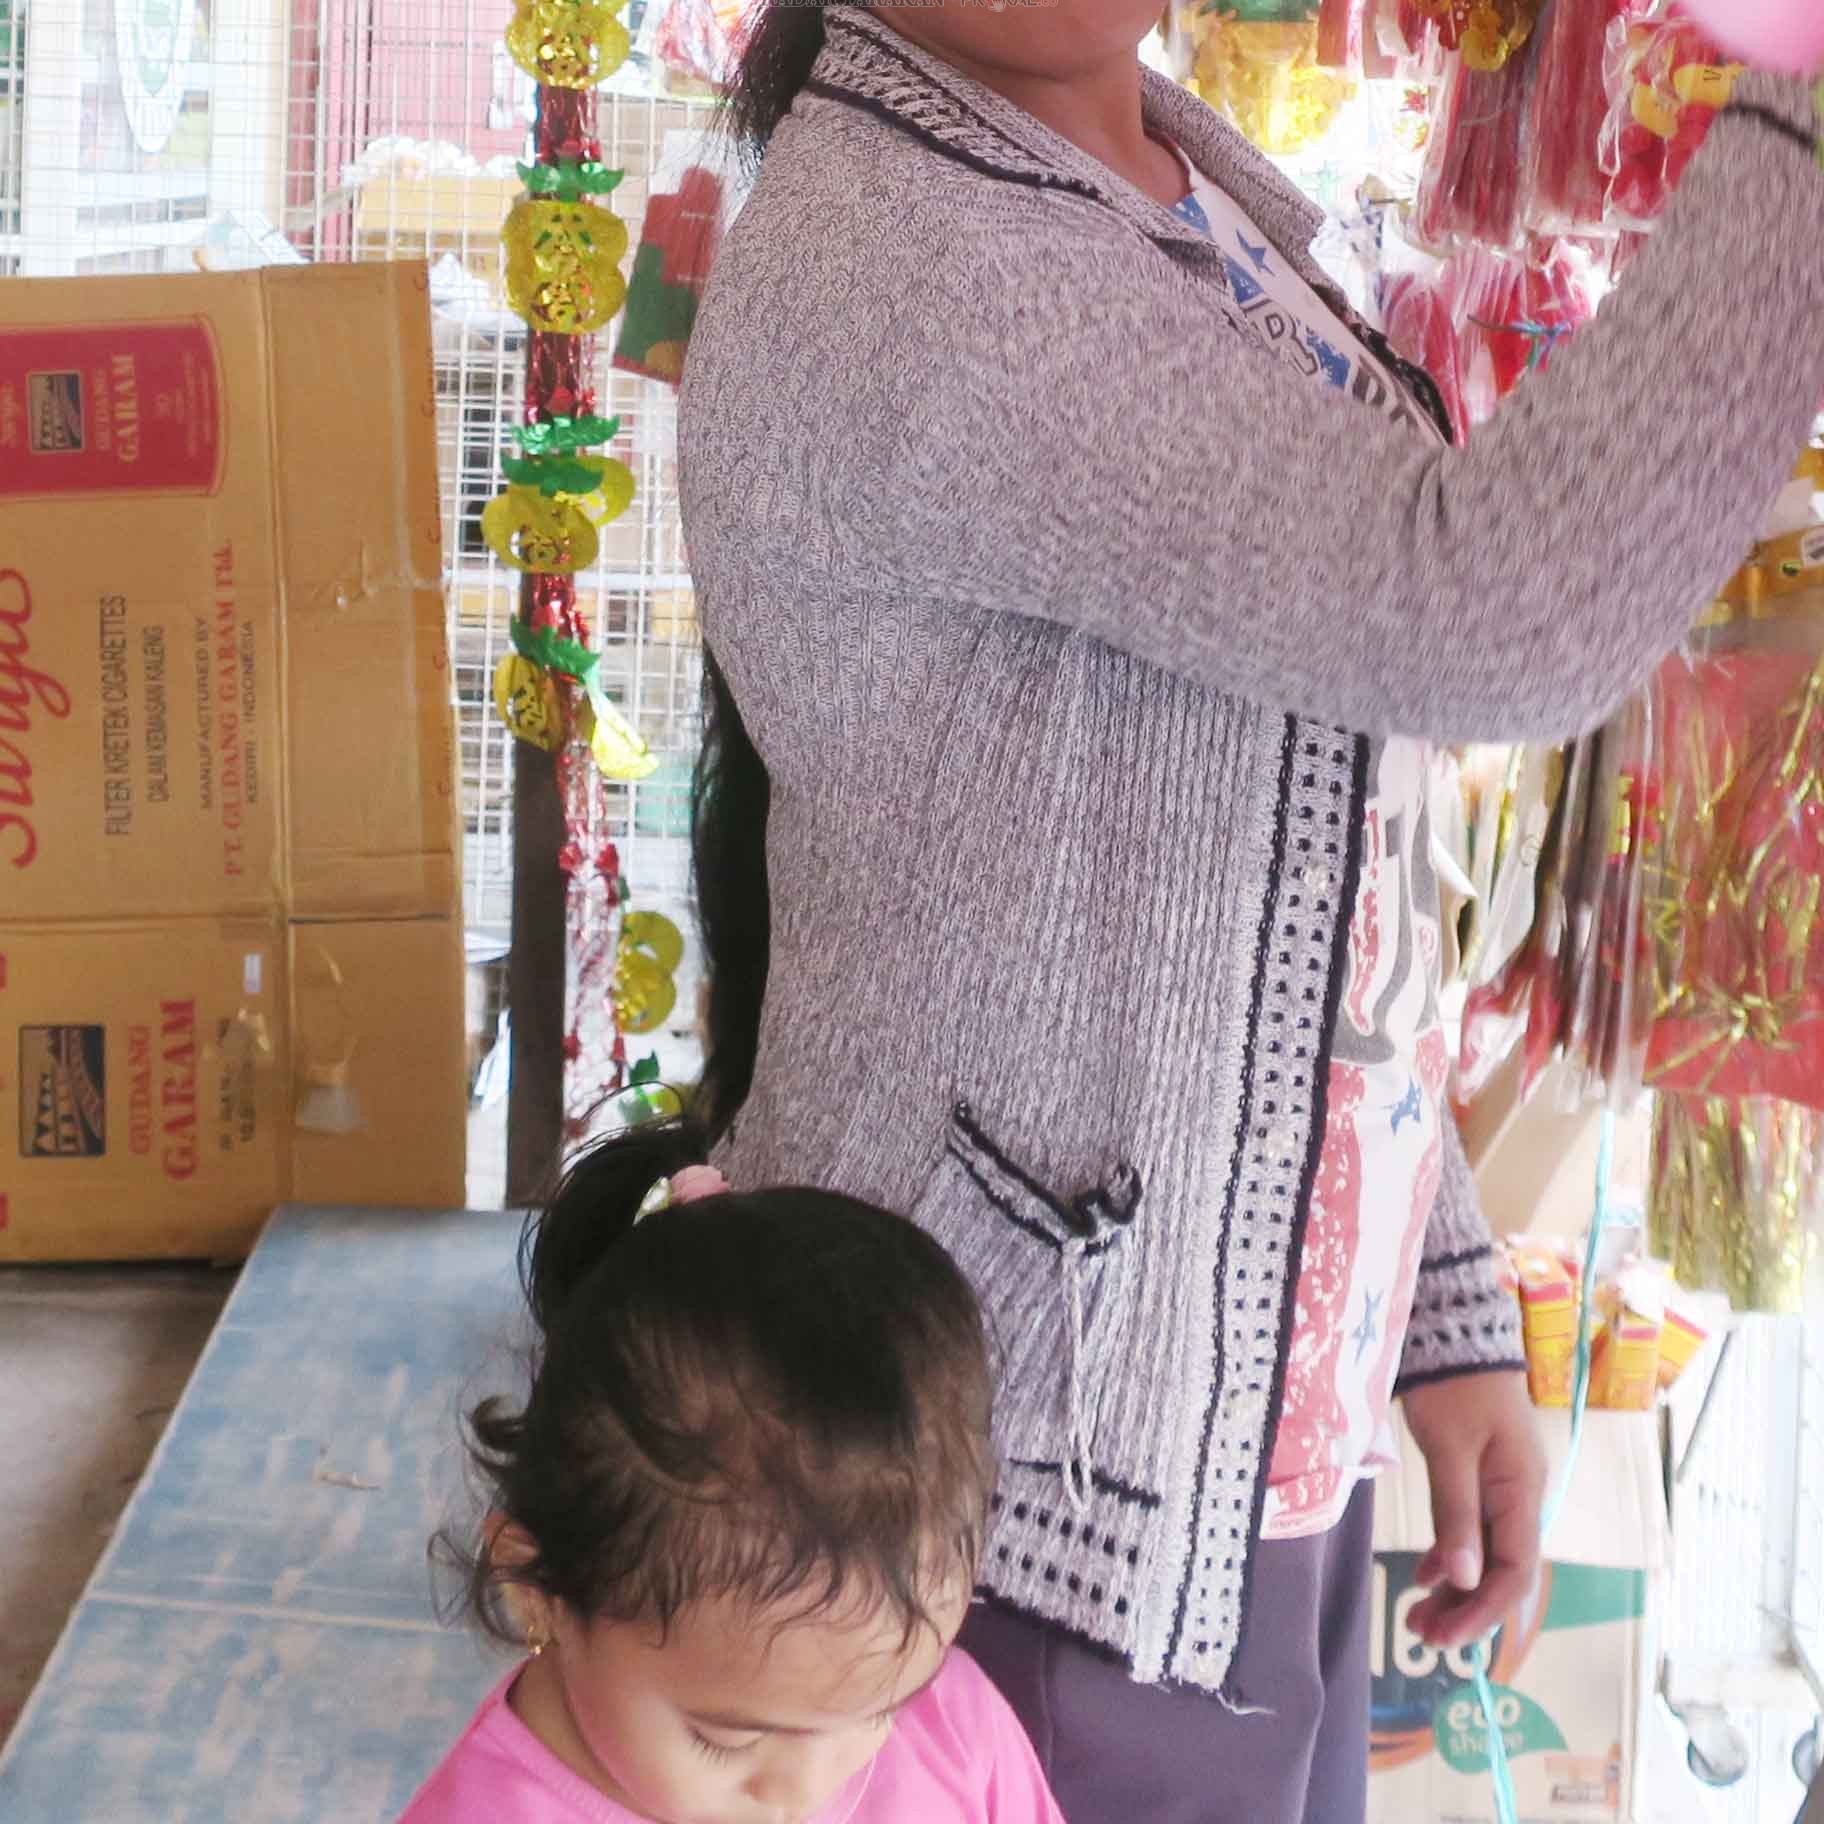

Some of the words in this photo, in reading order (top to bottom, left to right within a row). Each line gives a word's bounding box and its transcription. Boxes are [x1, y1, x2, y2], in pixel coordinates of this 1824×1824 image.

[112, 352, 139, 463] GARAM
[99, 594, 128, 703] CIGARETTES
[142, 625, 165, 681] KALENG
[195, 617, 209, 642] BY
[215, 601, 238, 702] GARAM
[240, 621, 256, 724] INDONESIA
[102, 706, 130, 774] KRETEK
[144, 684, 168, 752] KEMASAN
[196, 649, 212, 810] MANUFACTURED
[104, 779, 132, 836] FILTER
[146, 755, 170, 803] DALAM
[219, 712, 242, 830] GUDANG
[243, 740, 258, 805] KEDIRI
[127, 1024, 153, 1155] GUDANG
[160, 996, 197, 1180] GARAM
